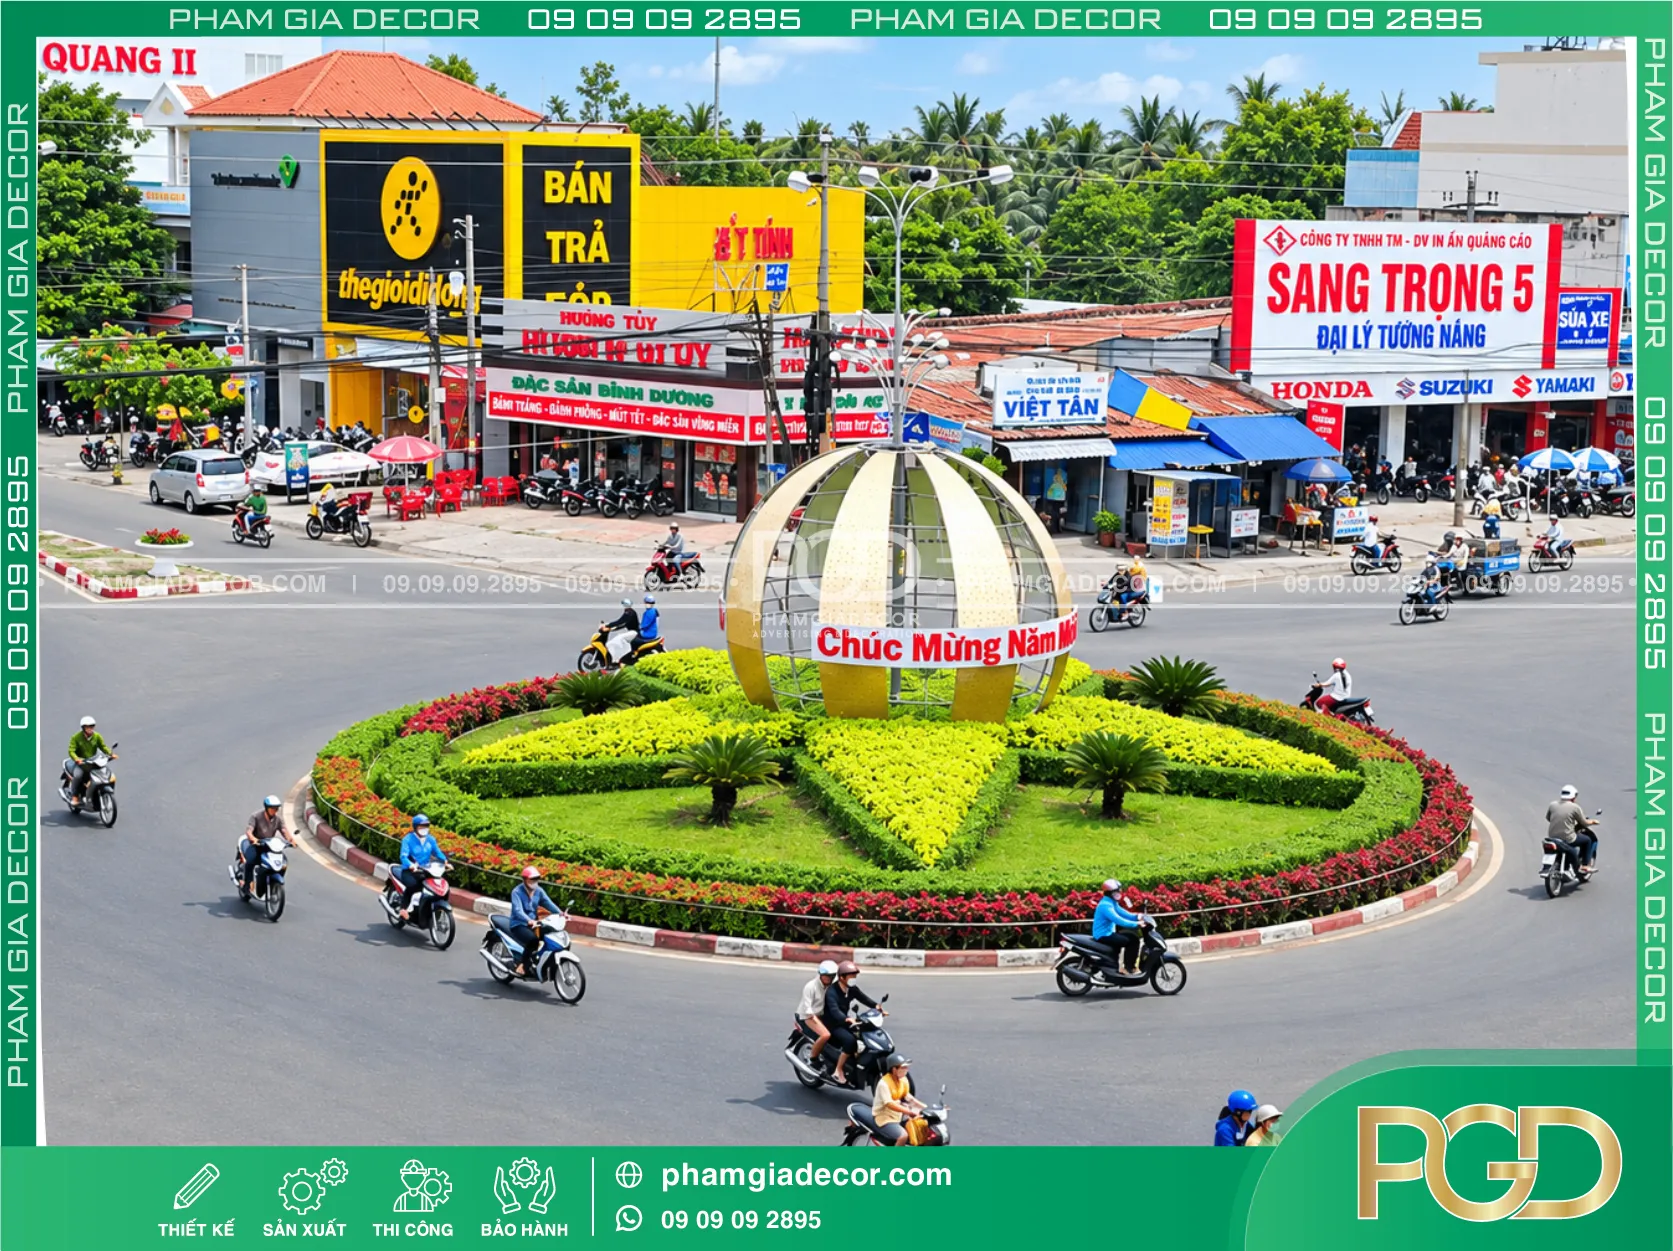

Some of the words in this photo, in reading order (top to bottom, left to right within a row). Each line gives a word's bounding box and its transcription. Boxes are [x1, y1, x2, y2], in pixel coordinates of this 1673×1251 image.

[42, 42, 162, 74] QUANG
[172, 49, 198, 76] II
[543, 160, 613, 205] BÁN
[545, 219, 611, 264] TRẢ
[1335, 233, 1350, 248] TY
[1353, 233, 1384, 248] TNHH
[1386, 233, 1404, 248] TM
[1413, 234, 1430, 248] DV
[1432, 234, 1445, 248] IN
[1509, 232, 1533, 249] CÁO
[1266, 261, 1371, 315] SANG
[1381, 262, 1504, 322] TRỌNG
[1513, 264, 1535, 313] 5
[1590, 311, 1610, 328] XE
[1316, 325, 1348, 356] ĐẠI
[1352, 319, 1374, 350] LÝ
[1270, 379, 1374, 401] HONDA
[1418, 377, 1494, 397] SUZUKI
[1535, 376, 1596, 394] YAMAKI
[1056, 394, 1100, 417] TÂN
[816, 626, 904, 661] Chúc
[912, 632, 1002, 667] Mừng
[1008, 627, 1057, 660] Năm
